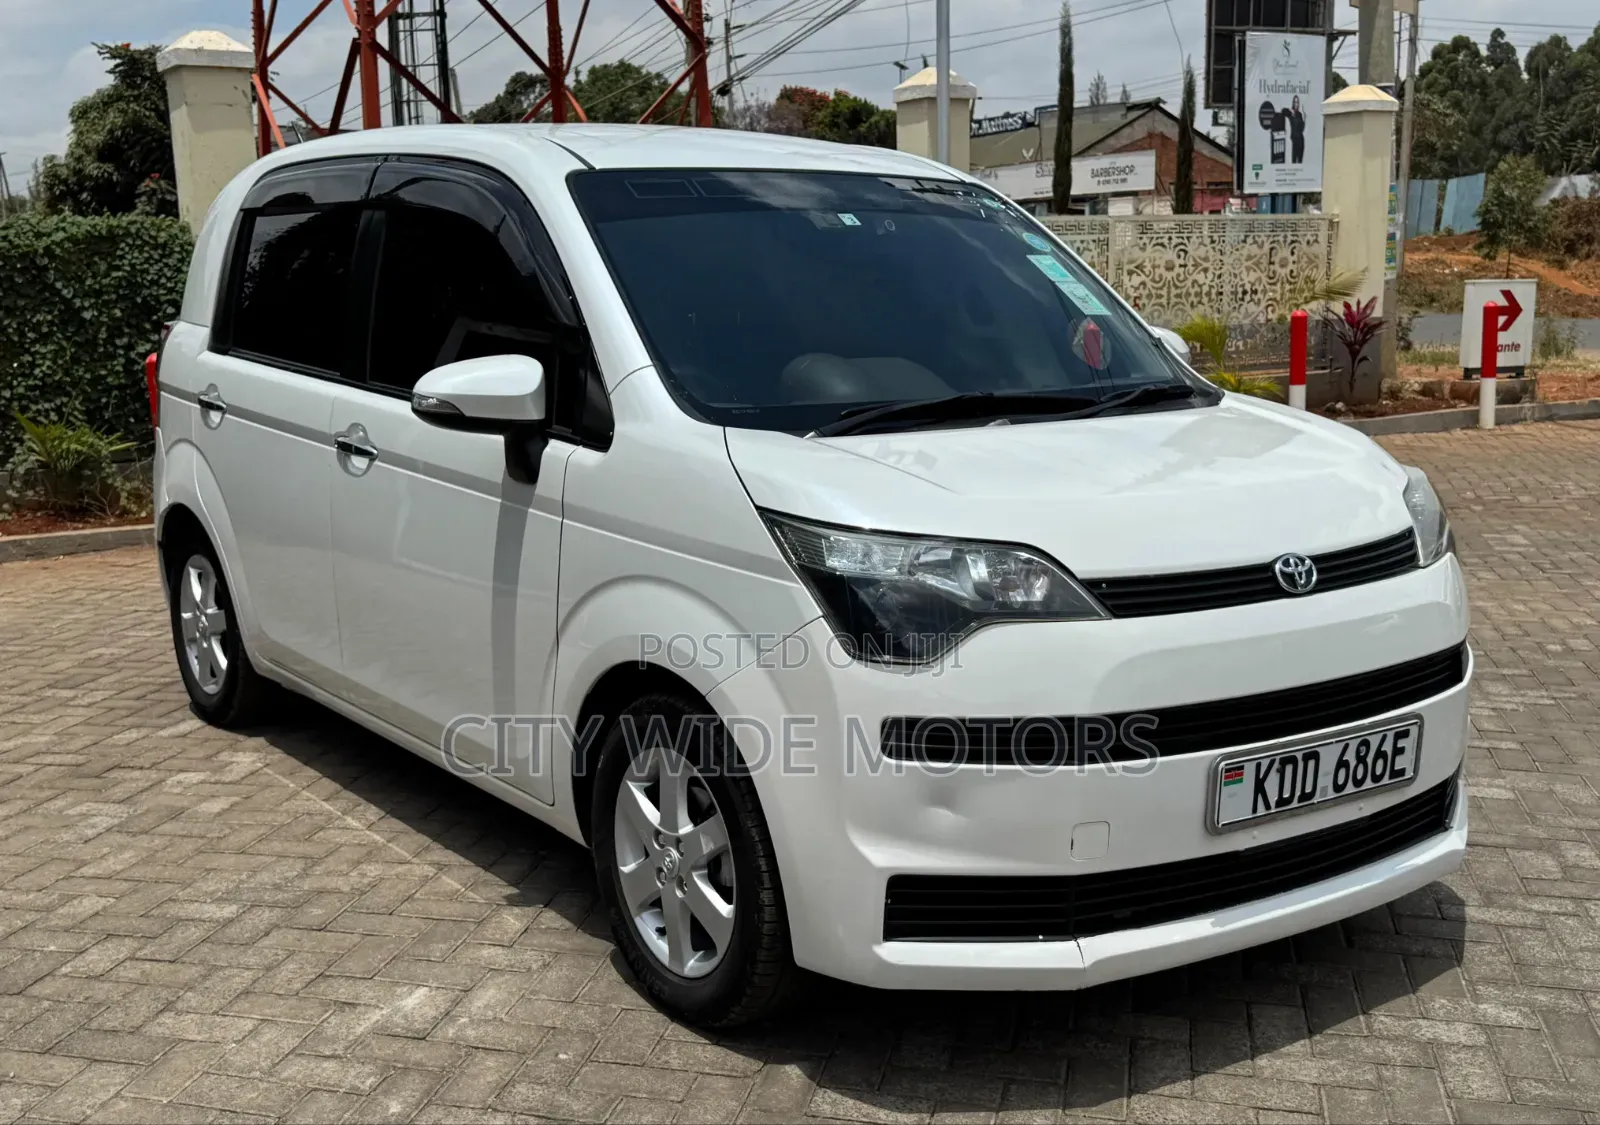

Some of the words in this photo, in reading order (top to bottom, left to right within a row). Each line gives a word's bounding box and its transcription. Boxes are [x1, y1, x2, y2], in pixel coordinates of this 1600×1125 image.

[1090, 164, 1136, 179] BARBERSHOP
[1497, 341, 1521, 352] ante
[1252, 750, 1320, 814] KDD
[1332, 728, 1411, 794] 686E
